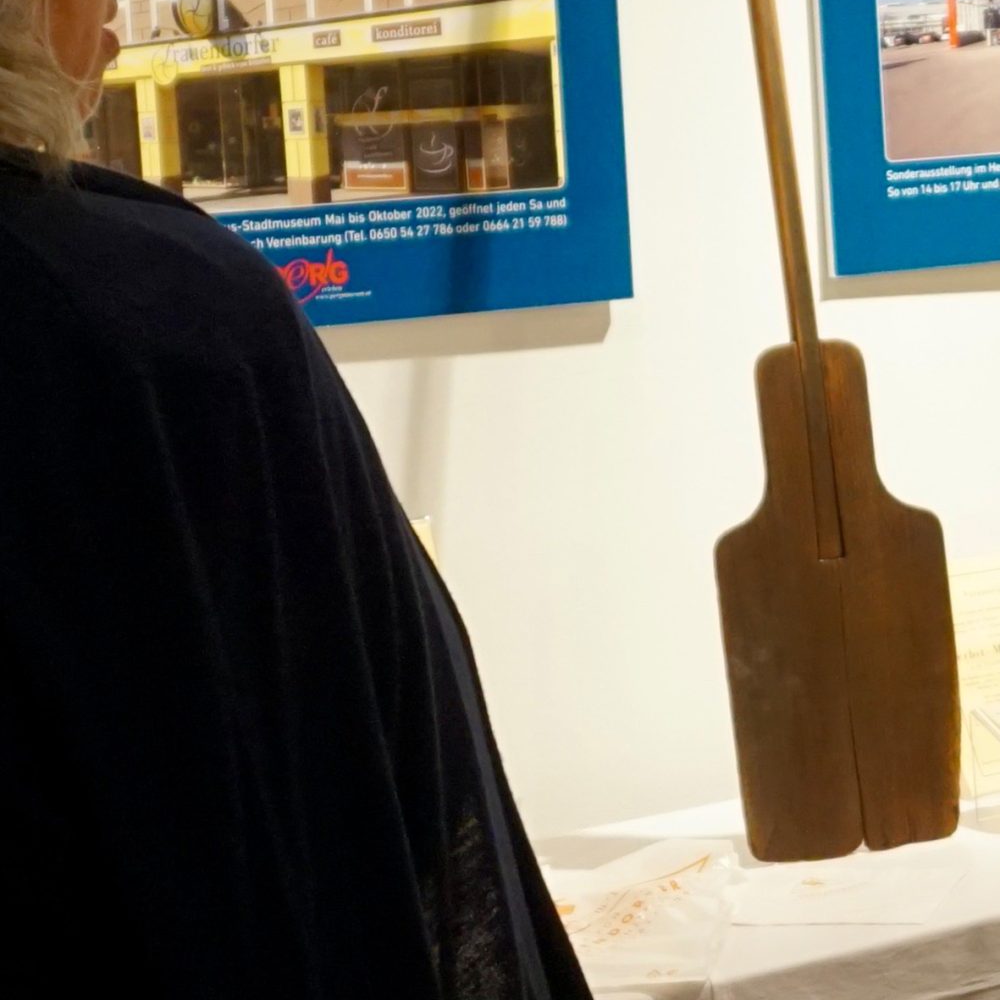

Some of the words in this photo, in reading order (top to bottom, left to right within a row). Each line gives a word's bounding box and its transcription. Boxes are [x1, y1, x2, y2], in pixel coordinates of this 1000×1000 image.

[314, 32, 339, 46] café
[375, 21, 438, 41] konditorei
[886, 162, 972, 183] Sonderausstellung
[973, 161, 986, 174] im
[886, 185, 900, 197] So
[900, 186, 918, 196] von
[920, 182, 932, 195] 14
[933, 181, 948, 194] bis
[950, 180, 961, 192] 17
[962, 178, 978, 191] Uhr
[980, 177, 999, 190] und
[324, 211, 344, 225] Mai
[348, 210, 364, 224] bis
[368, 207, 412, 222] Oktober
[415, 204, 446, 221] 2022,
[448, 201, 493, 219] geöffnet
[496, 199, 526, 216] jeden
[528, 197, 542, 211] Sa
[546, 196, 566, 209] und
[265, 231, 342, 250] Vereinbarung
[344, 229, 366, 244] (Tel.
[368, 226, 396, 240] 0650
[398, 225, 414, 238] 54
[416, 224, 430, 237] 27
[432, 222, 453, 236] 786
[454, 220, 480, 234] oder
[482, 218, 510, 232] 0664
[512, 217, 524, 230] 21
[526, 215, 542, 229] 59
[542, 213, 566, 227] 788)
